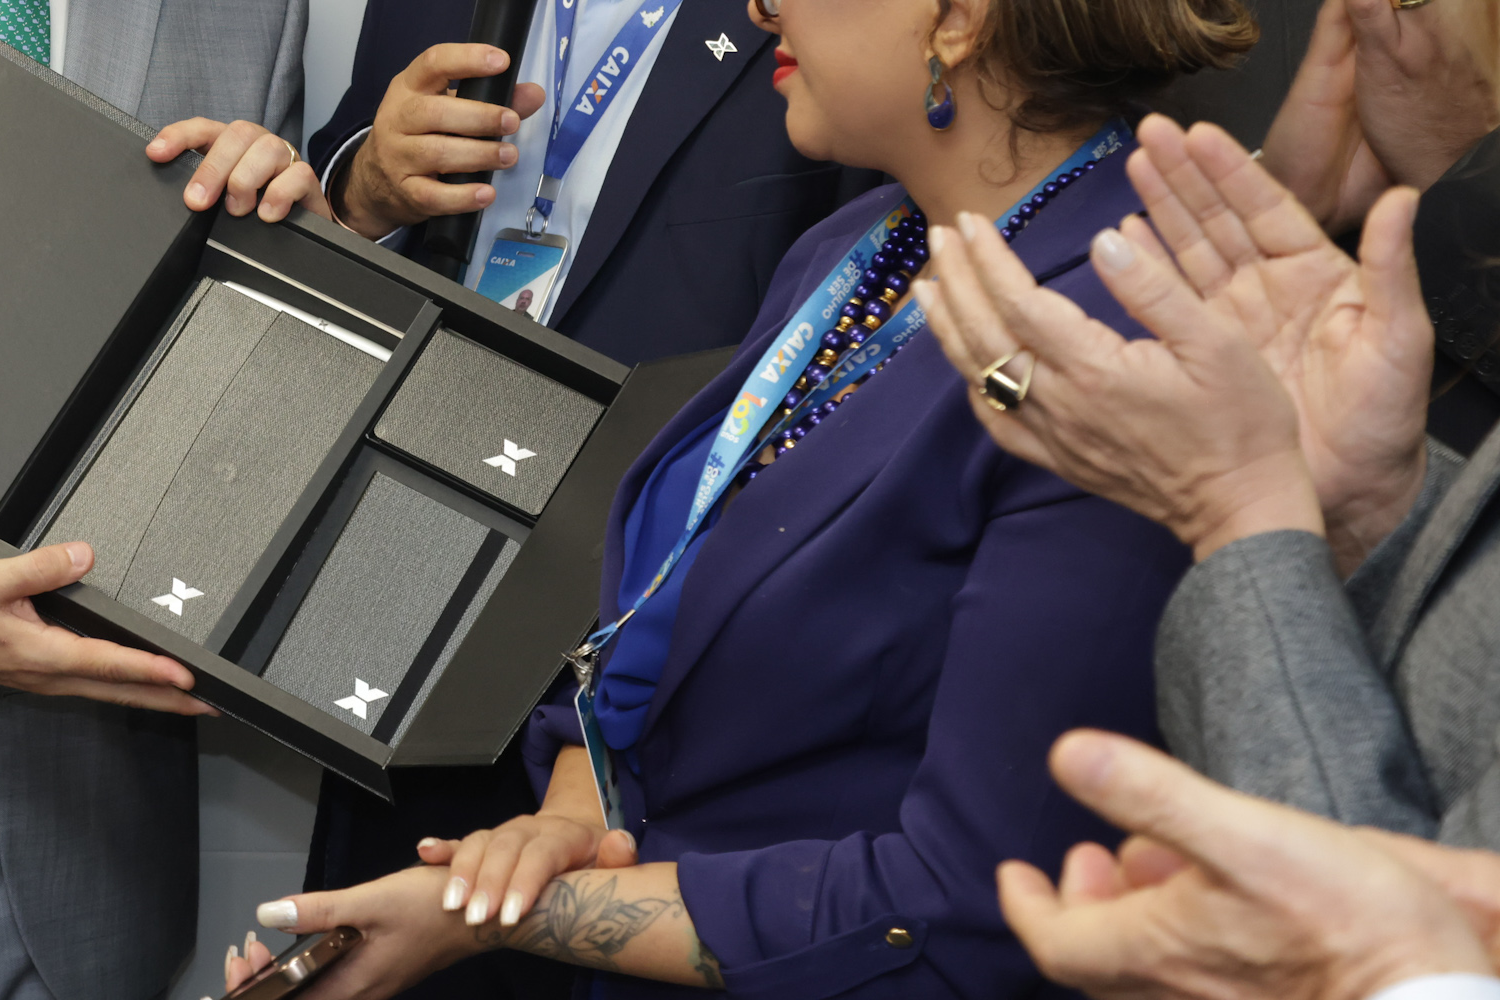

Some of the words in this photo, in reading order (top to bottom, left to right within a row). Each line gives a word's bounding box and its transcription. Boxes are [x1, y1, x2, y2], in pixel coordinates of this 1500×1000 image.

[575, 46, 629, 116] CAIXA
[490, 256, 516, 267] CAIXA
[826, 275, 845, 296] SER
[759, 321, 815, 384] CAIXA
